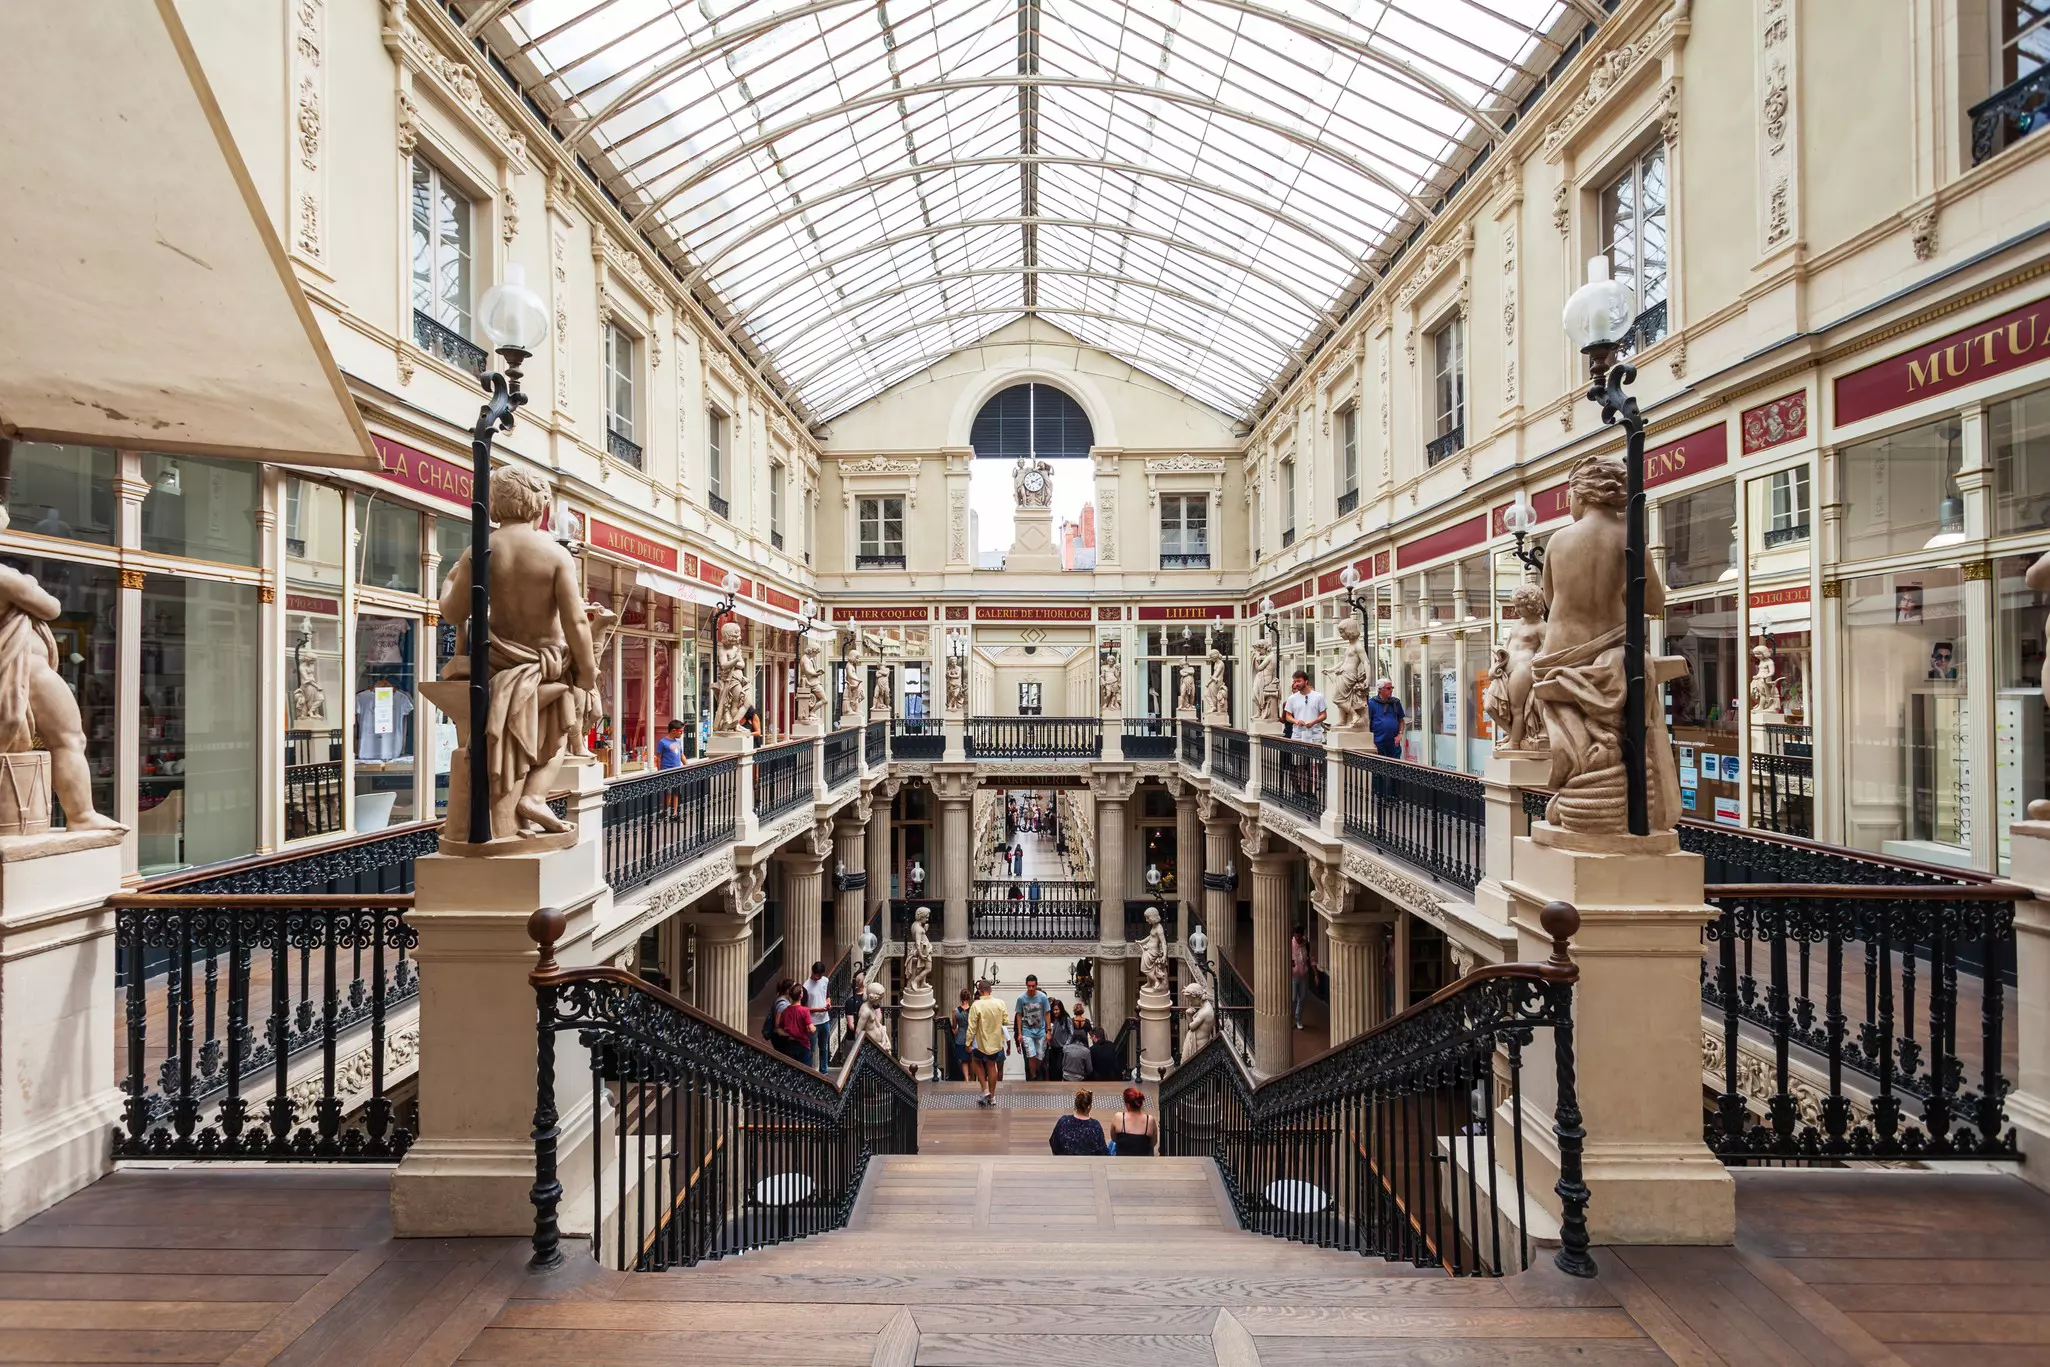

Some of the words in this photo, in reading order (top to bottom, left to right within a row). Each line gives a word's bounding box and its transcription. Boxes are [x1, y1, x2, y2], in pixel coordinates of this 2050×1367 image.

[382, 447, 409, 478] LA
[1643, 446, 1686, 481] ENS
[607, 531, 635, 555] ALICE
[636, 539, 666, 563] DELICE
[834, 610, 879, 618] ATELIER
[880, 609, 927, 619] COQLICO
[977, 609, 1019, 618] GALERIE
[1021, 610, 1034, 618] DE
[1035, 609, 1090, 618] L'HORLOGE
[1166, 608, 1207, 618] LILITH
